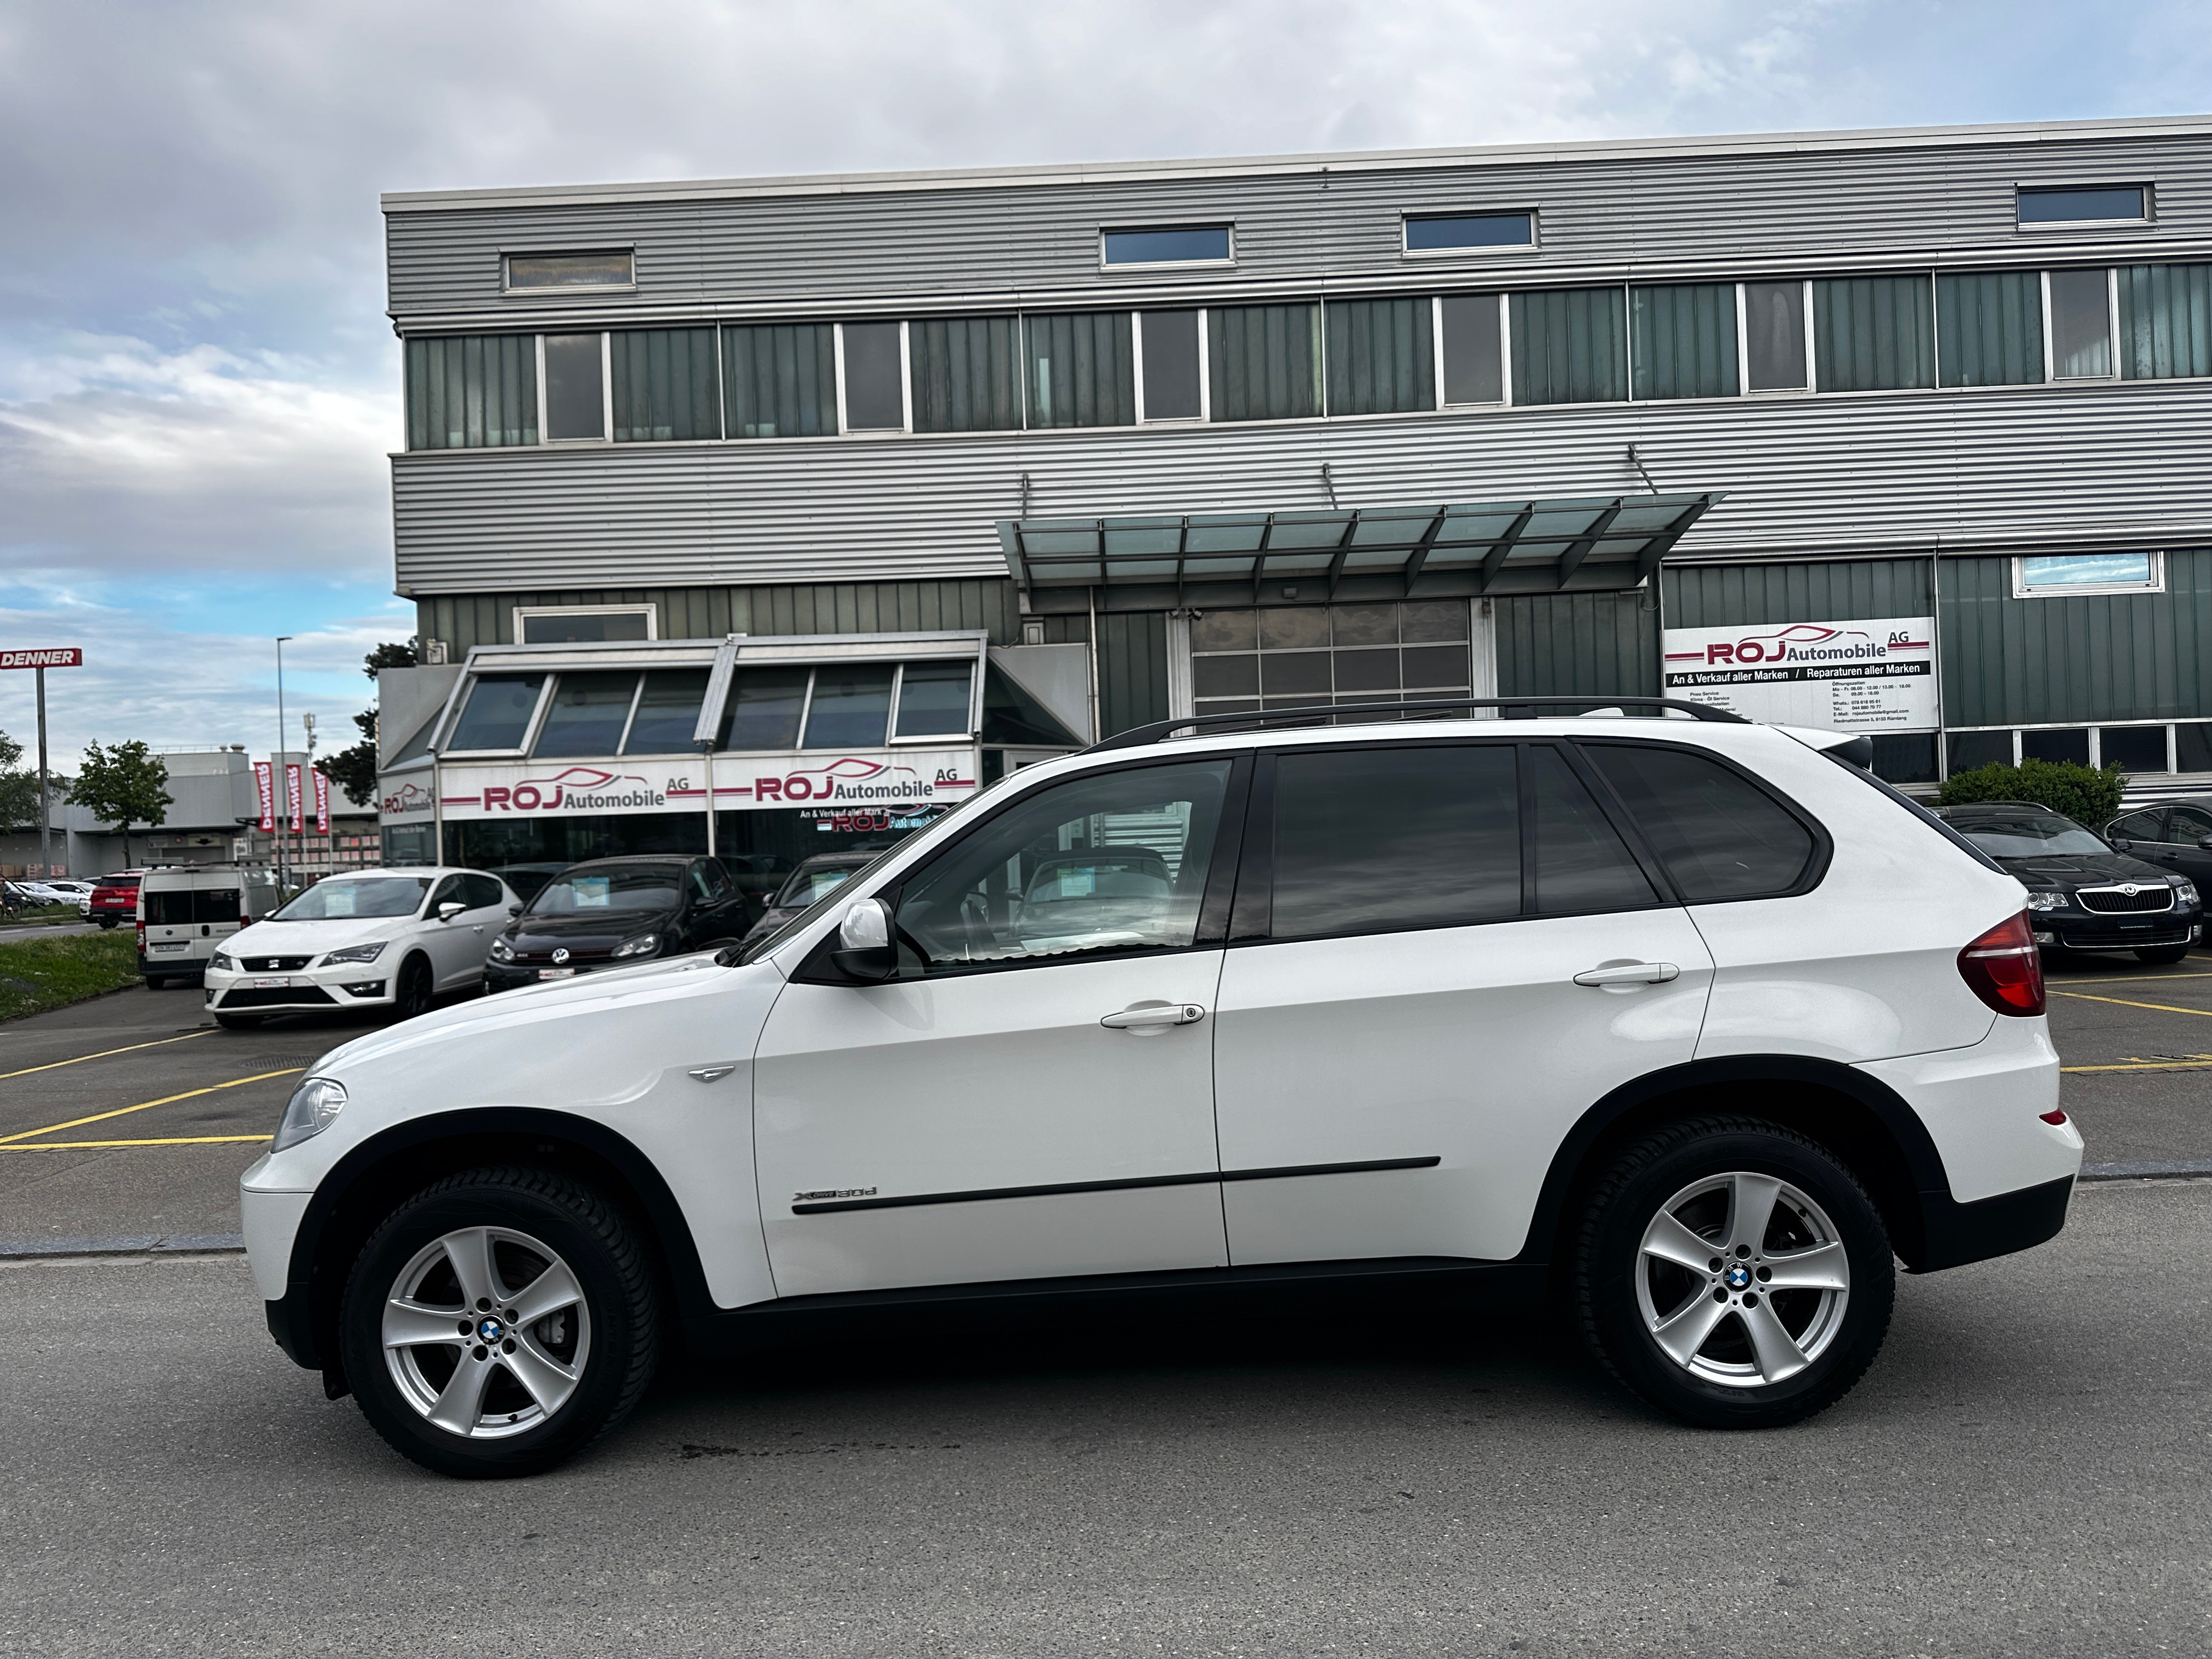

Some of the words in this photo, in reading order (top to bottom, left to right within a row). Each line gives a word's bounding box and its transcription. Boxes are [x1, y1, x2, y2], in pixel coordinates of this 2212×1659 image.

[1707, 641, 1785, 664] ROJ
[1786, 644, 1886, 662] Automobile
[1888, 631, 1909, 643] AG
[1, 650, 74, 667] DENNER
[1673, 675, 1685, 684] An
[1688, 674, 1694, 684] &
[1696, 672, 1730, 683] Verkauf
[1733, 671, 1752, 681] aller
[1754, 670, 1788, 680] Marken
[1807, 667, 1862, 679] Reparaturen
[1864, 665, 1884, 675] aller
[1886, 663, 1920, 674] Marken
[484, 785, 563, 811] ROJ
[563, 789, 665, 809] Automobile
[667, 777, 689, 791] AG
[755, 776, 833, 802] ROJ
[834, 781, 933, 799] Automobile
[936, 769, 958, 781] AG
[385, 795, 404, 814] ROJ
[800, 810, 811, 818] An
[819, 808, 846, 818] Verkauf
[832, 813, 890, 832] ROJ
